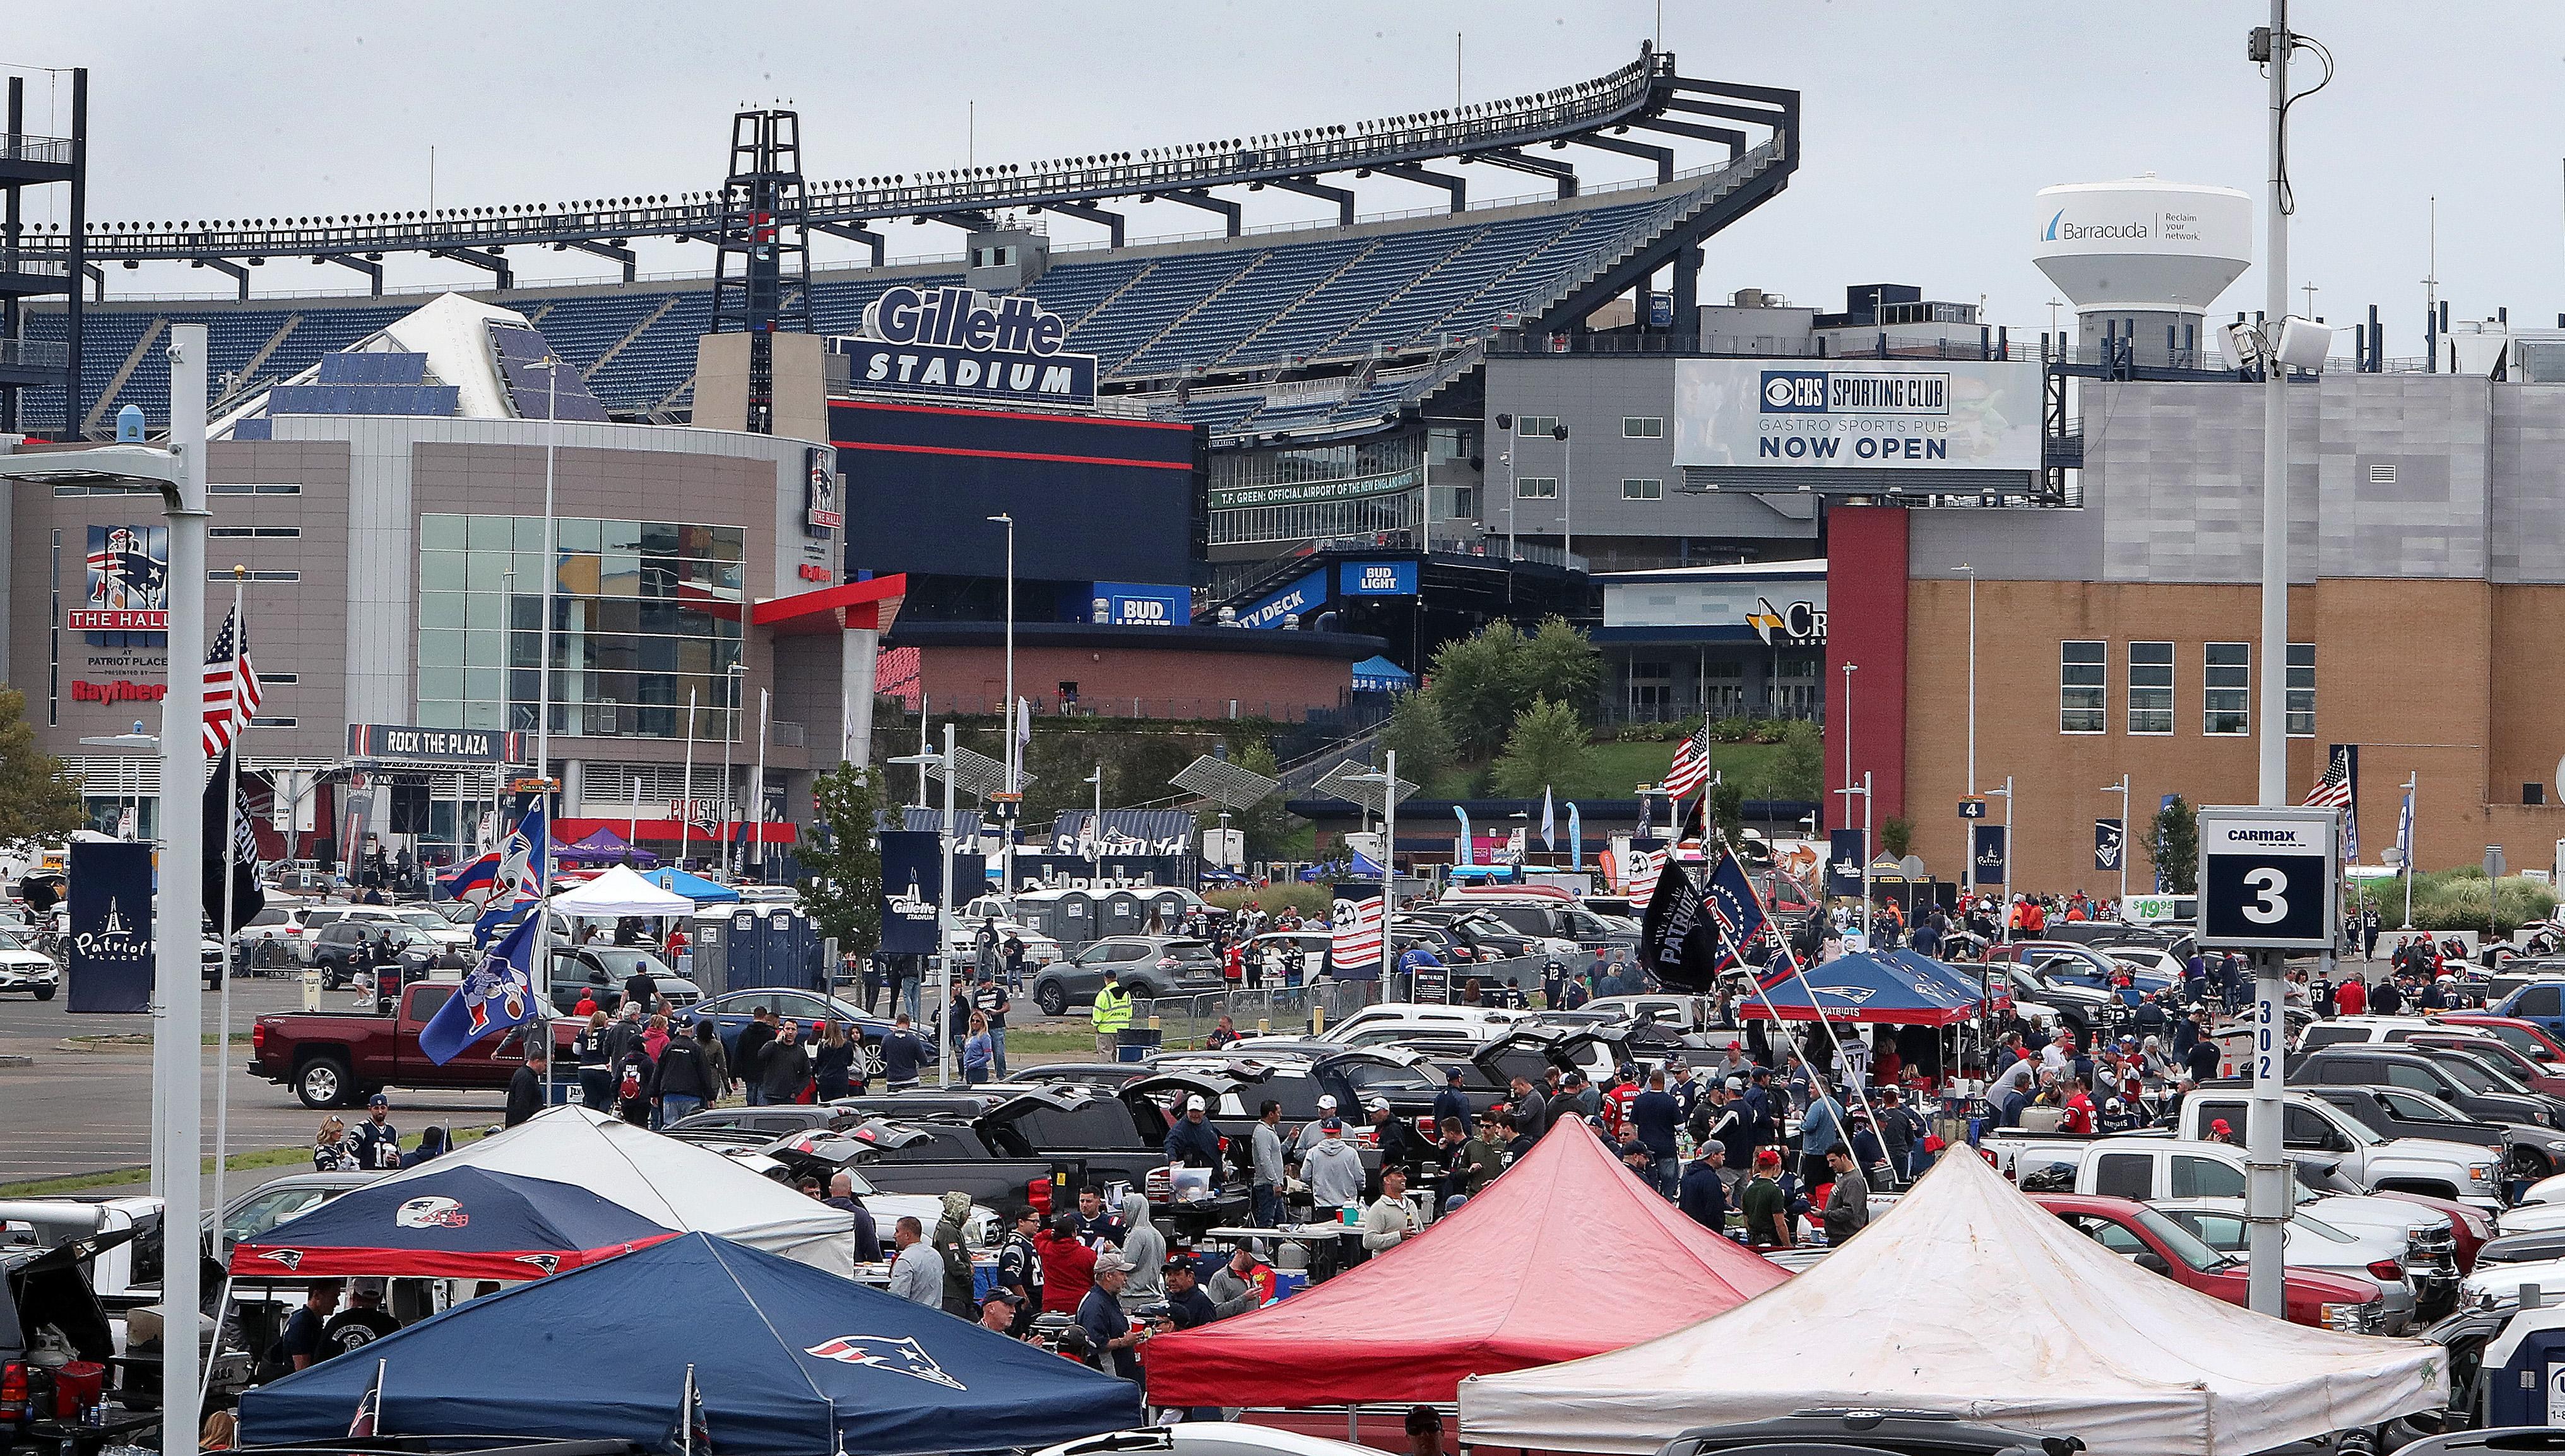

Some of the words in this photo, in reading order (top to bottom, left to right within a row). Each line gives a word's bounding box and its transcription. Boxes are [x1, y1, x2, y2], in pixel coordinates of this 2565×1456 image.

[2165, 213, 2196, 222] Reclaim
[2064, 222, 2147, 240] Barracuda
[874, 286, 1065, 357] Gillette
[867, 353, 1072, 394] STADIUM
[1794, 379, 1823, 407] CBS
[1833, 379, 1903, 407] SPORTING
[1907, 379, 1943, 408] CLUB
[1759, 419, 1830, 432] GASTRO
[1839, 419, 1906, 432] SPORTS
[1914, 420, 1948, 432] PUB
[1758, 435, 1840, 459] NOW
[1854, 437, 1947, 460] OPEN
[1221, 493, 1235, 504] T.F.
[1237, 490, 1266, 503] GREEN:
[1268, 487, 1302, 500] OFFICIAL
[1303, 483, 1336, 498] AIRPORT
[1337, 483, 1347, 496] OF
[1348, 482, 1361, 494] THE
[1361, 480, 1373, 492] NEW
[1374, 476, 1398, 490] ENGLAND
[814, 511, 825, 523] THE
[1366, 567, 1392, 578] BUD
[1361, 578, 1397, 589] LIGHT
[1123, 600, 1164, 619] BUD
[1261, 589, 1305, 622] DECK
[72, 612, 112, 626] THE
[119, 612, 169, 626] HALL
[88, 657, 131, 666] PATRIOT
[133, 657, 168, 666] PLACE
[72, 680, 167, 706] Raytheo
[387, 730, 420, 753] ROCK
[423, 732, 447, 755] THE
[449, 733, 489, 756] PLAZA
[997, 802, 1006, 818] 4
[1014, 802, 1020, 818] 4
[1965, 803, 1978, 817] 4
[1977, 855, 2003, 865] Patriot
[2242, 867, 2289, 924] 3
[892, 901, 937, 914] Gillette
[1198, 924, 1206, 935] 11
[1660, 885, 1698, 965] PATRIOT
[2367, 917, 2376, 928] 12
[74, 932, 148, 956] Patriot
[1765, 935, 1779, 948] 12
[862, 958, 874, 972] 12
[1549, 969, 1559, 981] 12
[2311, 989, 2324, 1002] 93
[1507, 998, 1519, 1009] 12
[1823, 1007, 1860, 1017] PATRIOTS
[586, 1038, 598, 1051] 12
[2259, 1000, 2272, 1079] 302
